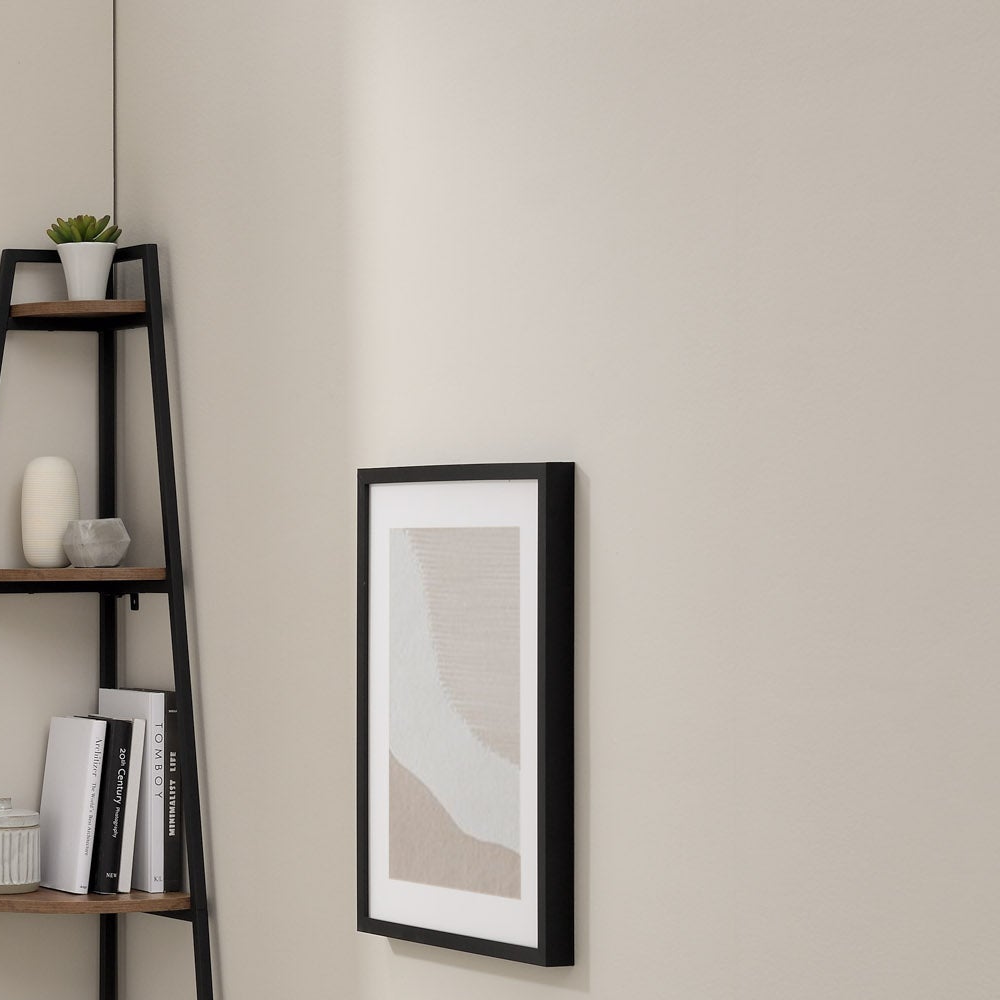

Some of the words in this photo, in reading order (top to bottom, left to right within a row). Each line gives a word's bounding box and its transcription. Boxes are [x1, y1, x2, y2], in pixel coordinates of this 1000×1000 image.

[154, 723, 164, 799] TOMBOY
[169, 751, 177, 772] LIFE
[113, 768, 126, 804] Century
[112, 806, 120, 839] Photography
[168, 779, 177, 837] MINIMALIST
